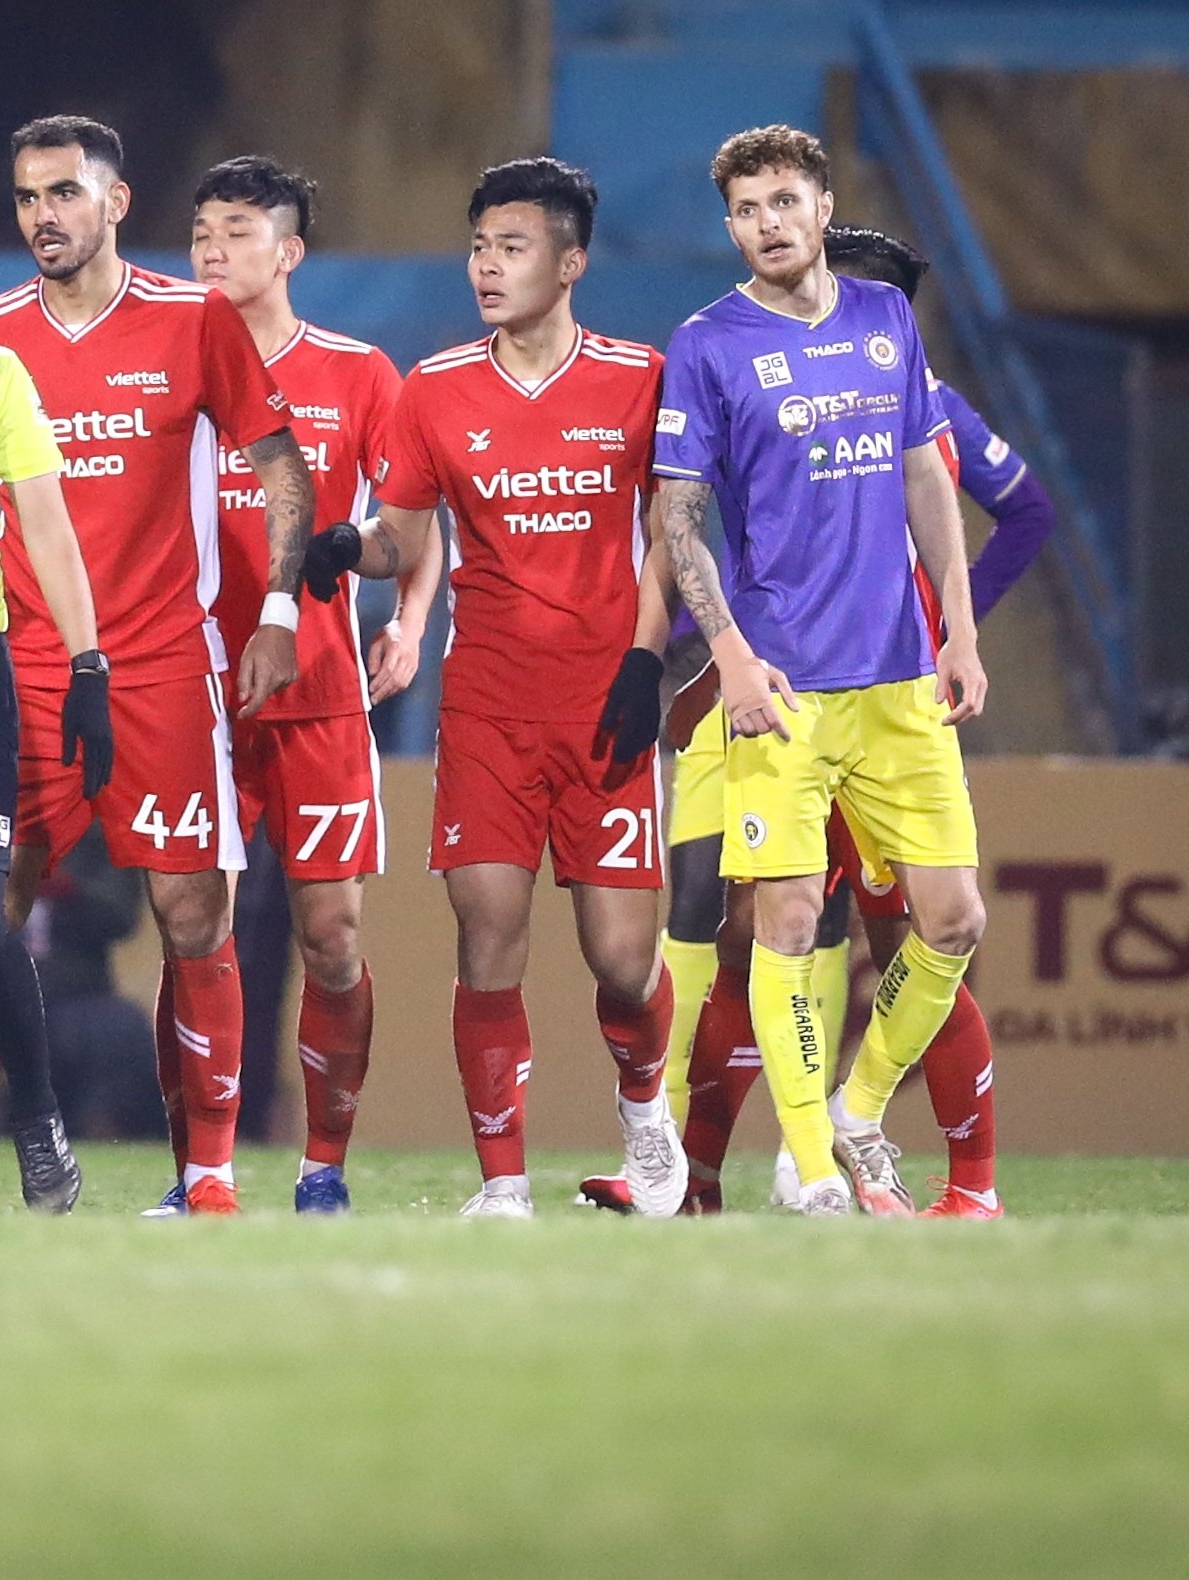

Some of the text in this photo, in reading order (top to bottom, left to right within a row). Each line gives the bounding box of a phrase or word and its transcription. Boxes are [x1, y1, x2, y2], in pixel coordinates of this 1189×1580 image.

[802, 341, 854, 358] THACO
[105, 371, 169, 387] viettel
[142, 386, 169, 394] sports
[51, 408, 152, 444] ettel
[561, 427, 625, 442] viettel
[599, 443, 625, 451] sports
[56, 454, 124, 478] HACO
[472, 464, 617, 499] viettel
[219, 488, 267, 510] THA
[503, 511, 592, 534] THACO
[131, 791, 212, 850] 44
[296, 799, 370, 862] 77
[597, 808, 653, 869] 21
